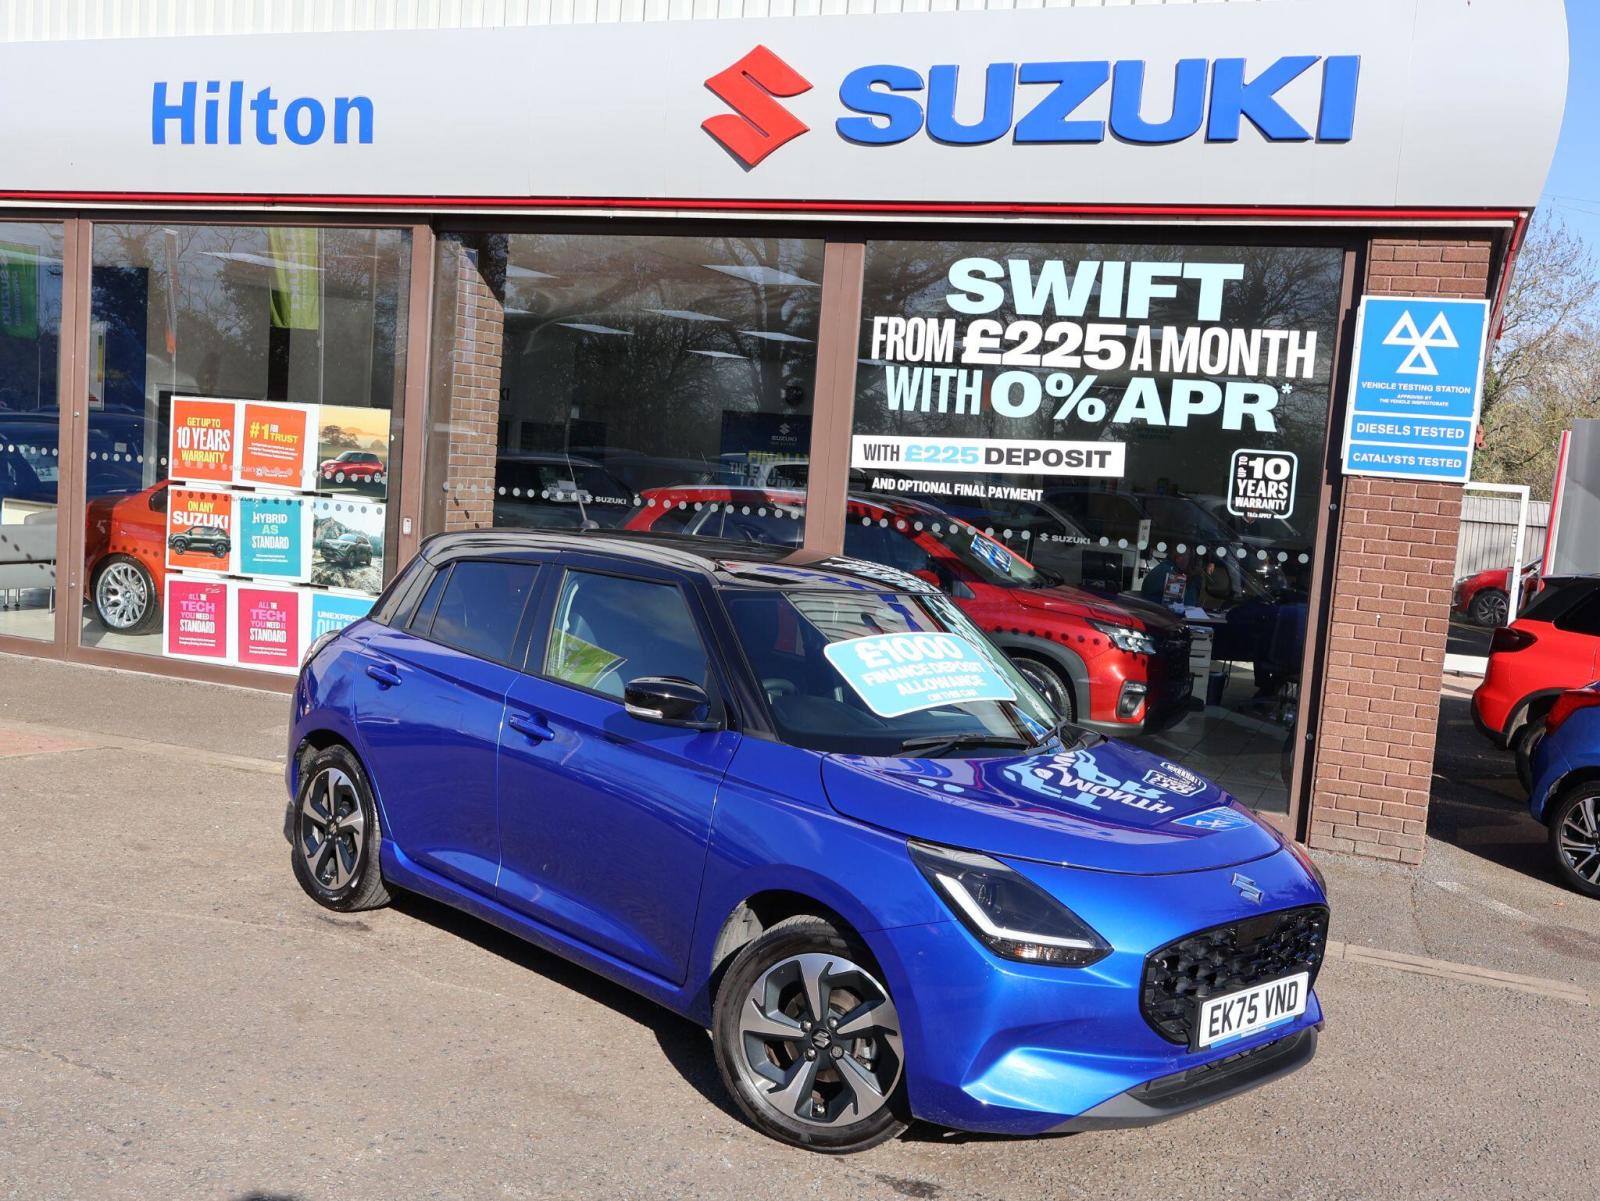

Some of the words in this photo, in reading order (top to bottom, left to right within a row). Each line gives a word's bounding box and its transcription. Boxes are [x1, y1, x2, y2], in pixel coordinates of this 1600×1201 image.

[836, 55, 1361, 145] SUZUKI
[152, 81, 374, 145] Hilton
[946, 257, 1245, 322] SWIFT
[871, 316, 956, 363] FROM
[961, 319, 1128, 371] £225
[1130, 325, 1152, 371] A
[1159, 325, 1318, 379] MONTH
[885, 366, 984, 416] WITH
[990, 370, 1106, 423] 0%
[1361, 381, 1396, 391] VEHICLE
[1398, 383, 1433, 393] TESTING
[1435, 385, 1472, 395] STATION
[187, 417, 202, 428] GET
[202, 418, 212, 429] UP
[249, 421, 270, 440] #1
[270, 432, 299, 443] TRUST
[1356, 422, 1411, 436] DIESELS
[1414, 425, 1465, 440] TESTED
[177, 426, 191, 449] 10
[192, 427, 231, 452] YEARS
[182, 449, 225, 463] WARRANTY
[863, 443, 900, 462] WITH
[905, 445, 979, 463] £225
[984, 448, 1112, 469] DEPOSIT
[1238, 456, 1249, 466] TO
[1352, 451, 1415, 465] CATALYSTS
[1418, 455, 1462, 469] TESTED
[1237, 466, 1248, 478] UP
[1249, 457, 1291, 480] 10
[872, 477, 894, 490] AND
[896, 479, 952, 495] OPTIONAL
[954, 483, 987, 497] FINAL
[988, 485, 1043, 501] PAYMENT
[1237, 478, 1289, 499] YEARS
[187, 500, 199, 511] ON
[200, 502, 214, 513] ANY
[595, 495, 627, 505] SUZUKI
[1235, 497, 1287, 511] WARRANTY
[172, 511, 229, 528] SUZUKI
[252, 512, 288, 524] HYBRID
[262, 525, 279, 535] AS
[252, 536, 290, 549] STANDARD
[1051, 534, 1091, 545] SUZUKI
[180, 601, 215, 612] TECH
[258, 601, 270, 609] ALL
[250, 609, 286, 621] TECH
[179, 619, 215, 634] STANDARD
[251, 620, 265, 628] YOU
[266, 621, 281, 629] NEED
[249, 628, 287, 643] STANDARD
[854, 636, 964, 669] £1000
[861, 665, 934, 686] FINANCE
[931, 660, 986, 674] DEPOSIT
[895, 675, 986, 697] ALLOWANCE
[1209, 992, 1259, 1038] EK75
[1265, 980, 1299, 1018] VND
